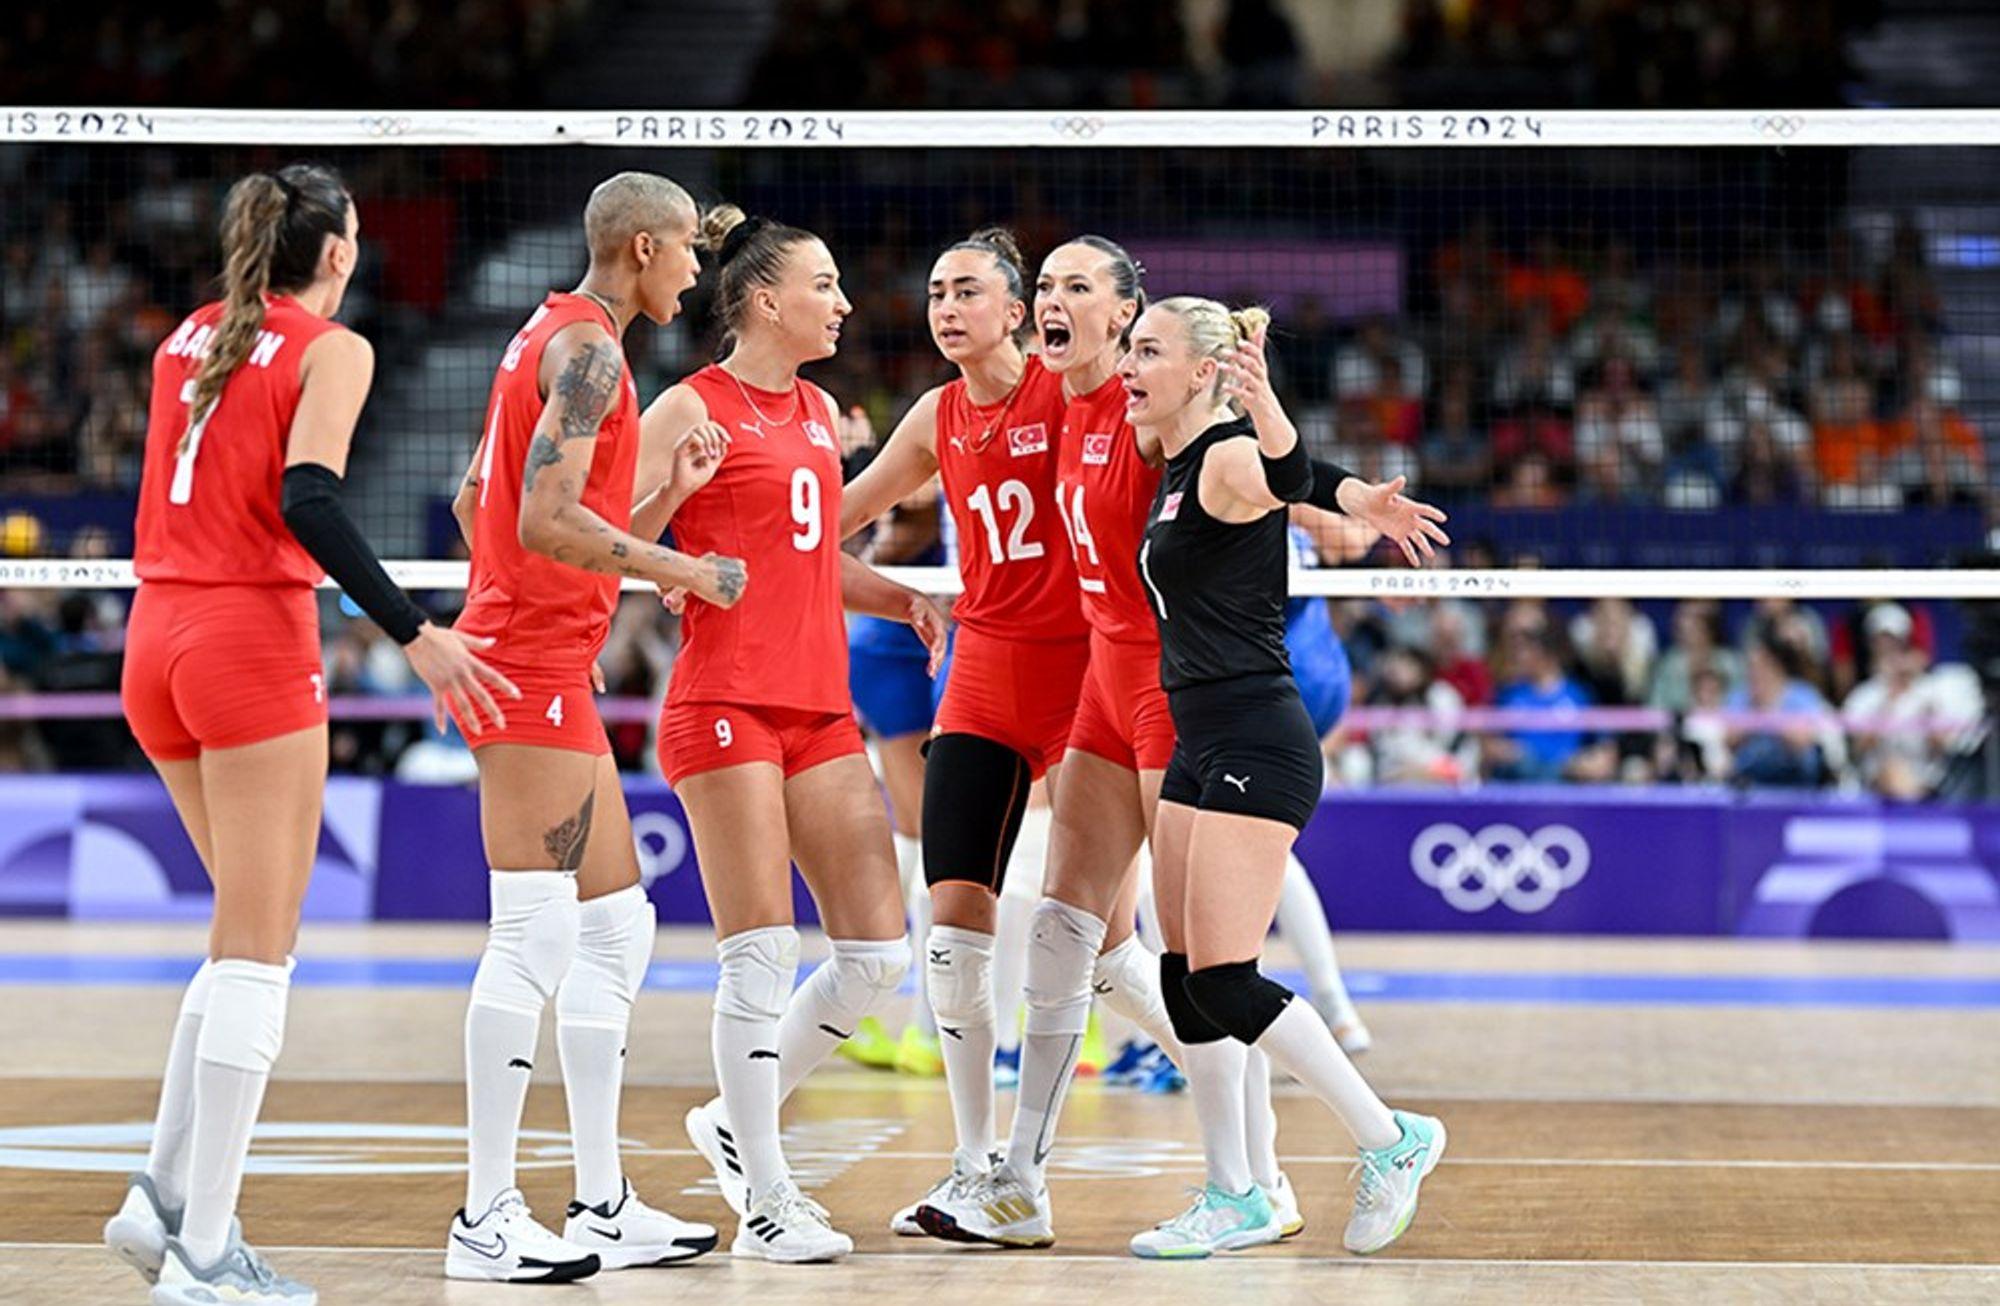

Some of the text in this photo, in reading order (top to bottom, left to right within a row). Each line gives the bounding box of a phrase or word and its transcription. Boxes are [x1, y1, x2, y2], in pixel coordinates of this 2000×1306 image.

[54, 111, 154, 135] 2024
[615, 115, 844, 140] PARIS 2024
[1311, 114, 1543, 139] PARIS 2024
[790, 465, 822, 552] 9
[966, 479, 1046, 565] 12
[1055, 480, 1100, 566] 14
[1370, 575, 1511, 592] PARIS 2024
[545, 694, 564, 727] 4
[714, 718, 733, 748] 9
